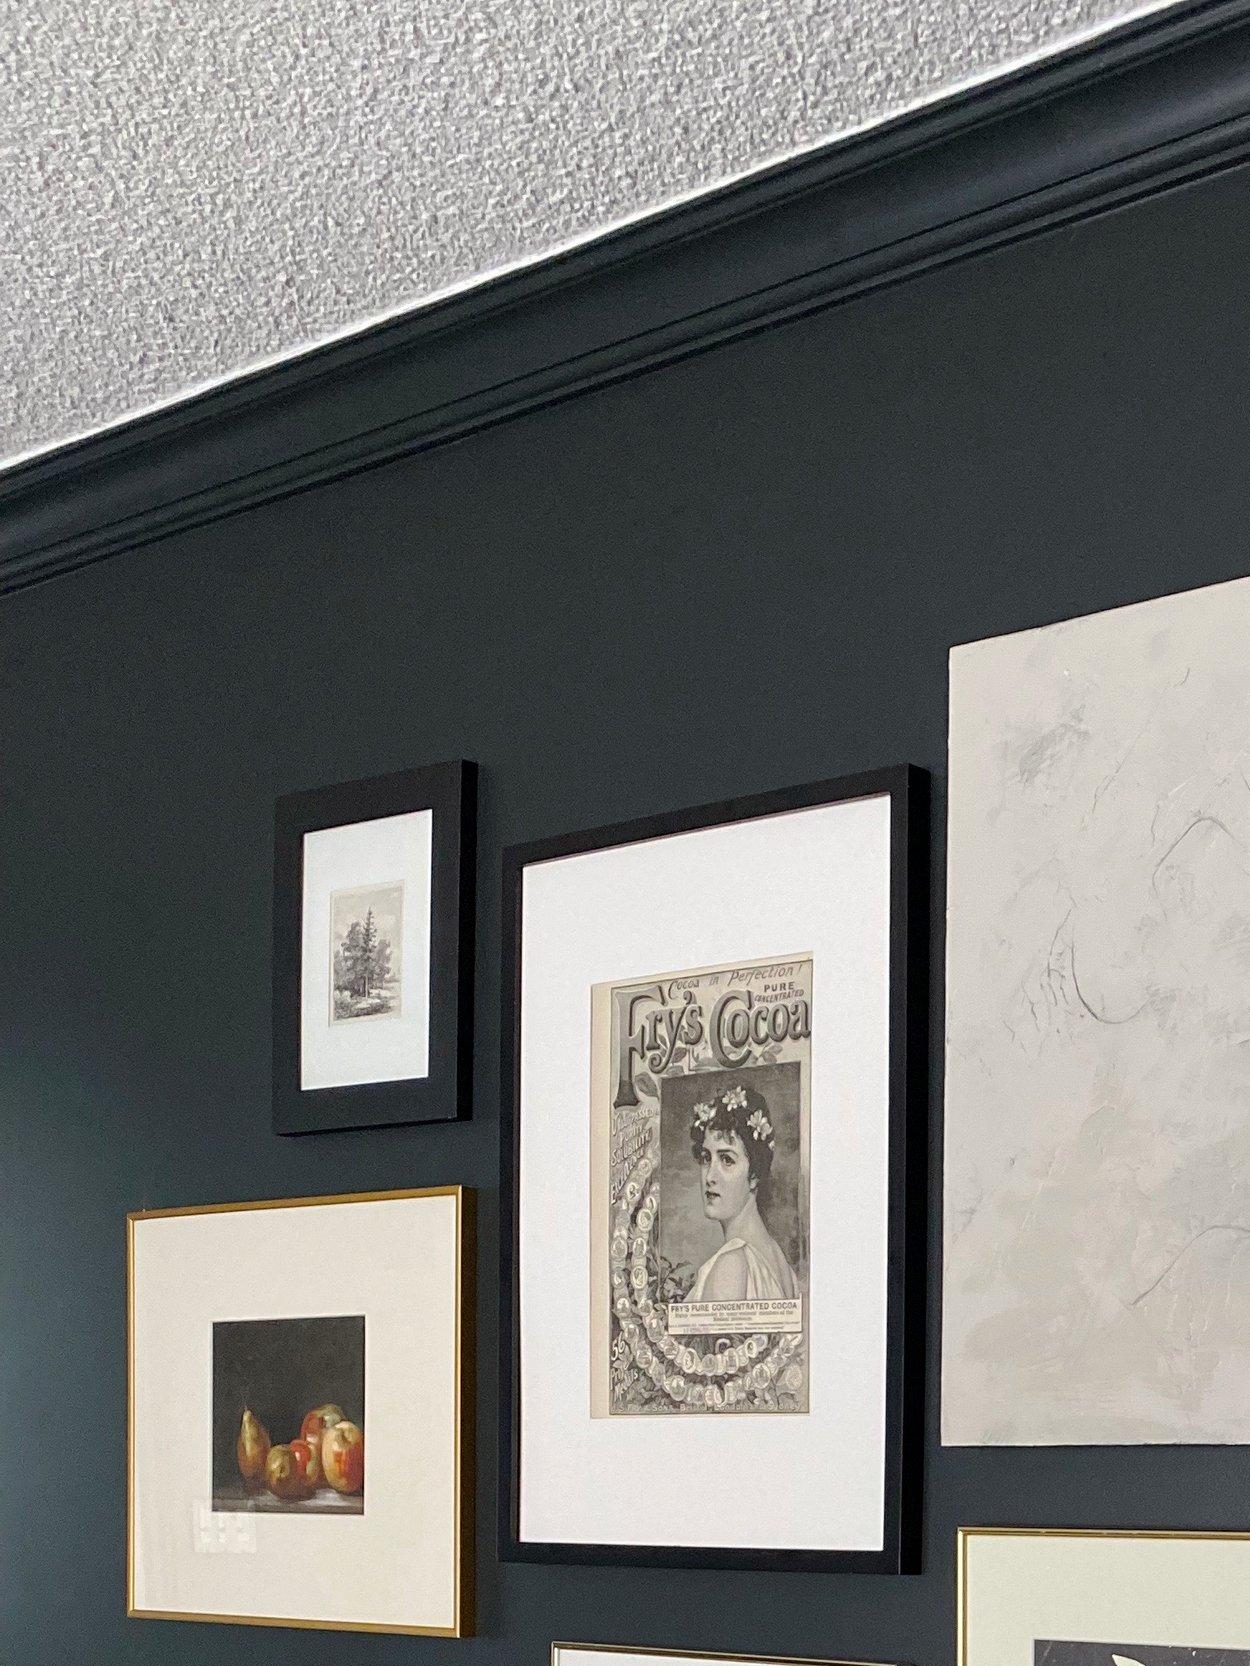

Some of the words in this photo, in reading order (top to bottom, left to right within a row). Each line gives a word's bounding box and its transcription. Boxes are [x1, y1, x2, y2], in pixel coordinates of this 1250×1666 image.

[668, 978, 700, 999] Cocoa
[709, 975, 719, 986] in
[764, 981, 795, 992] PURE
[754, 988, 805, 1003] CONCENTRATED
[612, 985, 704, 1109] Fry's
[709, 990, 812, 1068] Cocoa
[692, 1303, 710, 1312] PURE
[712, 1303, 770, 1312] CONCENTRATED
[772, 1301, 798, 1310] COCOA
